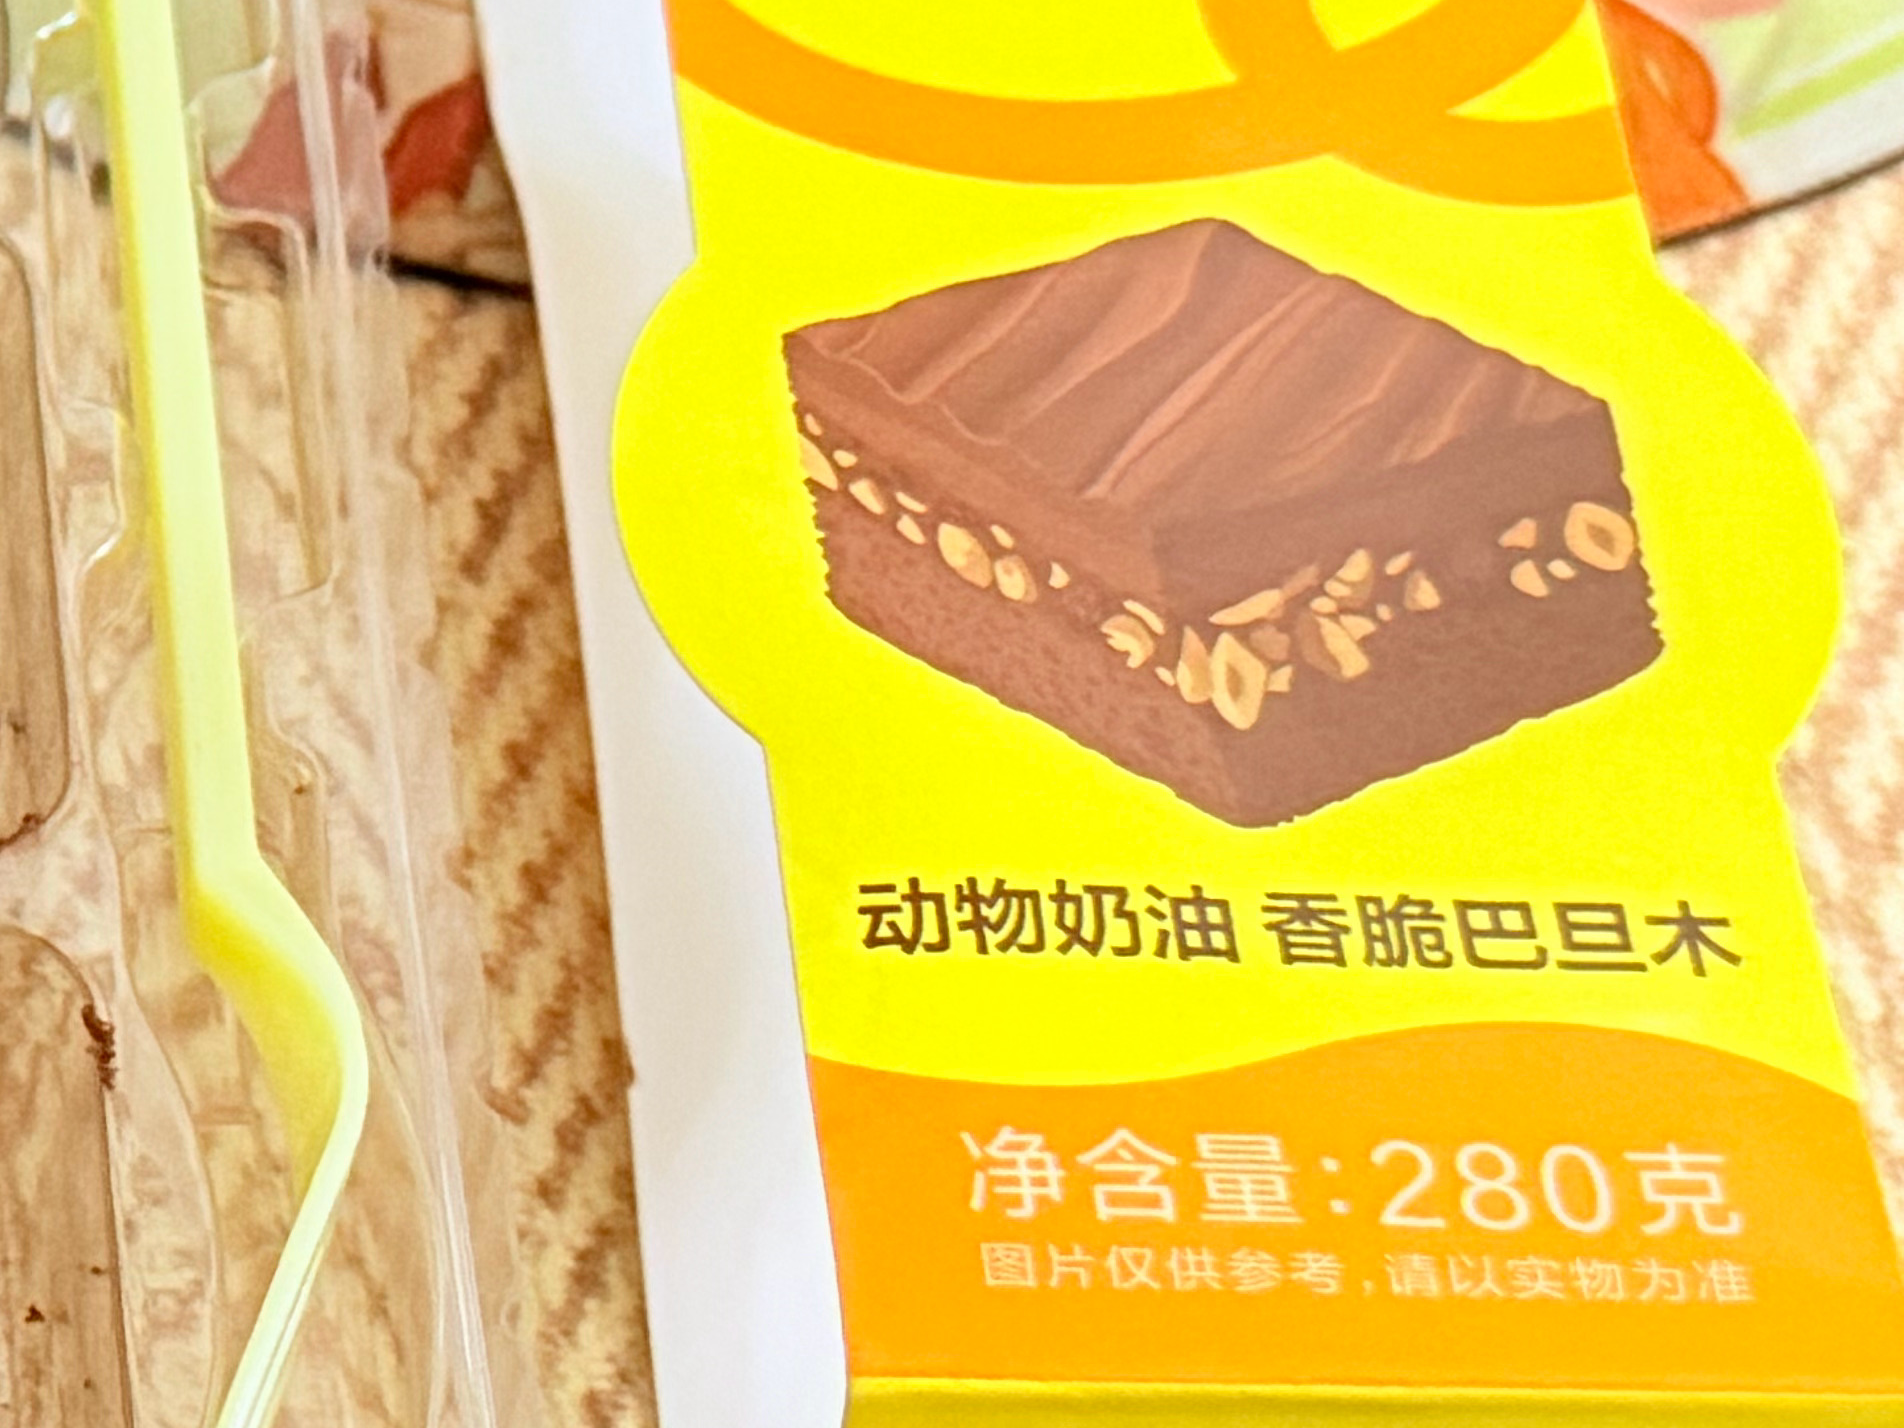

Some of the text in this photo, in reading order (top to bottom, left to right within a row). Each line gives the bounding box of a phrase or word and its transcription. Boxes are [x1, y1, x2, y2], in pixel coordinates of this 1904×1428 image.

[855, 876, 1743, 978] 动物奶油 香脆巴旦木
